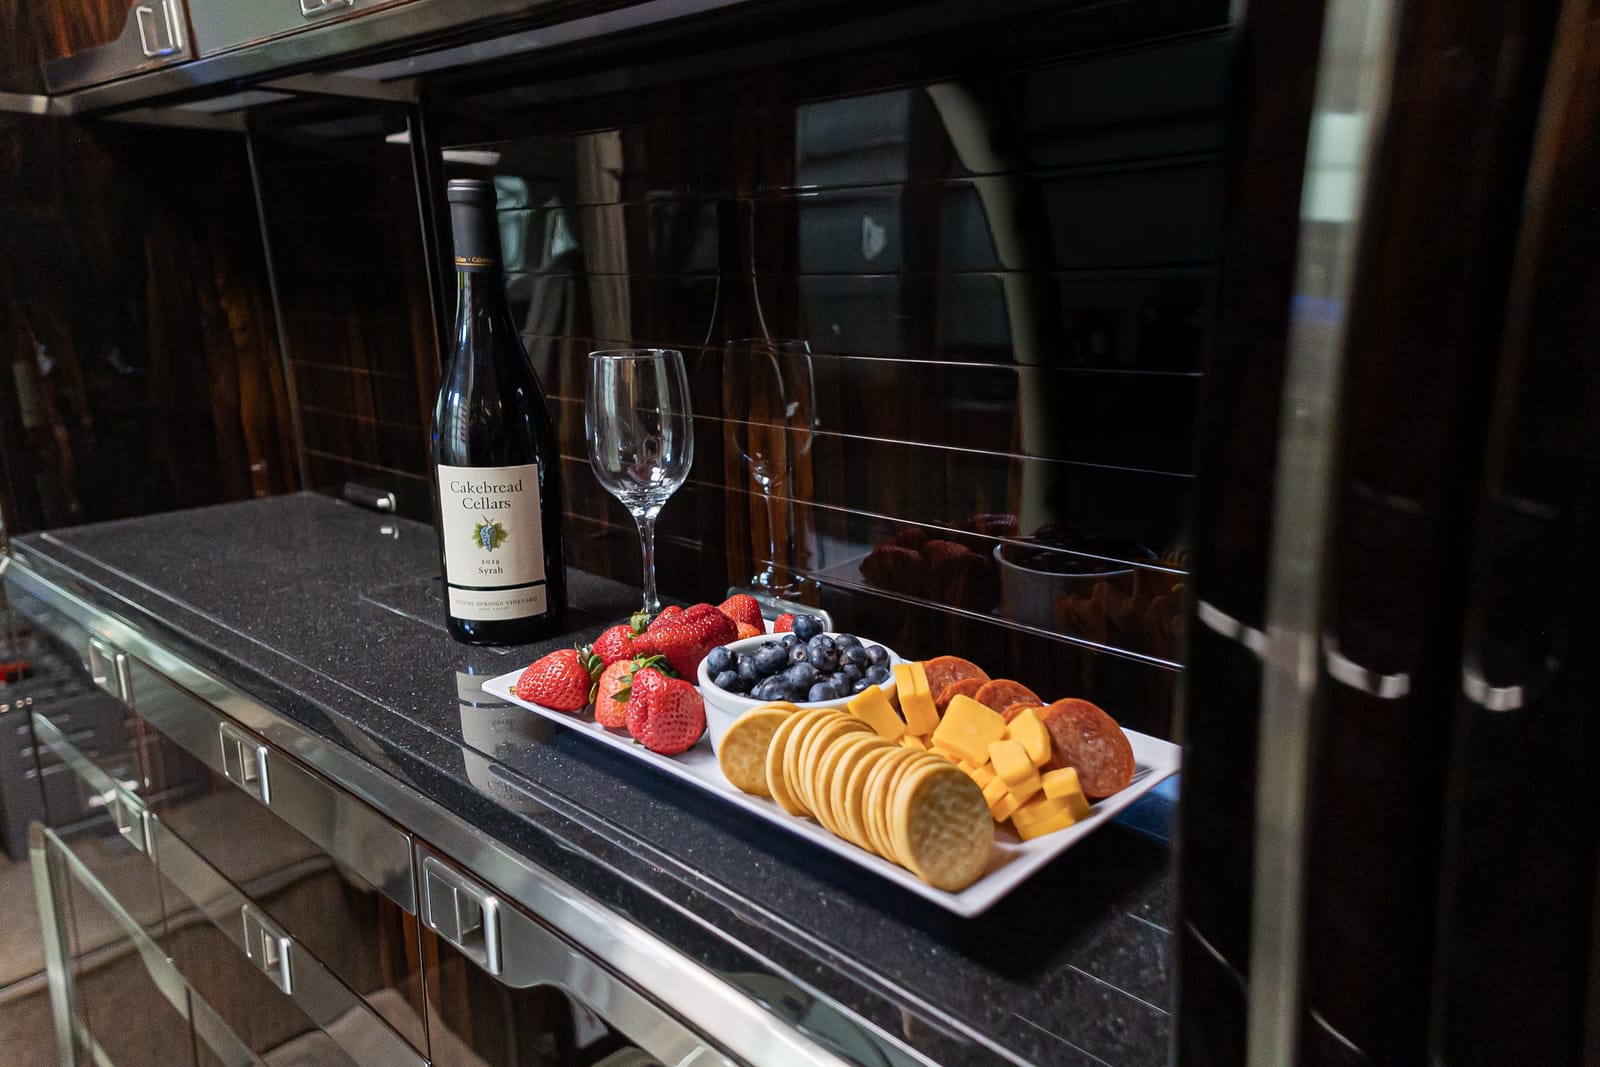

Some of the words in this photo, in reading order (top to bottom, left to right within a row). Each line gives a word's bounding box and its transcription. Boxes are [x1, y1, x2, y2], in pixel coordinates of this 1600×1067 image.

[450, 479, 523, 494] Cakebread
[462, 497, 511, 510] Cellars
[478, 565, 503, 576] Syrah
